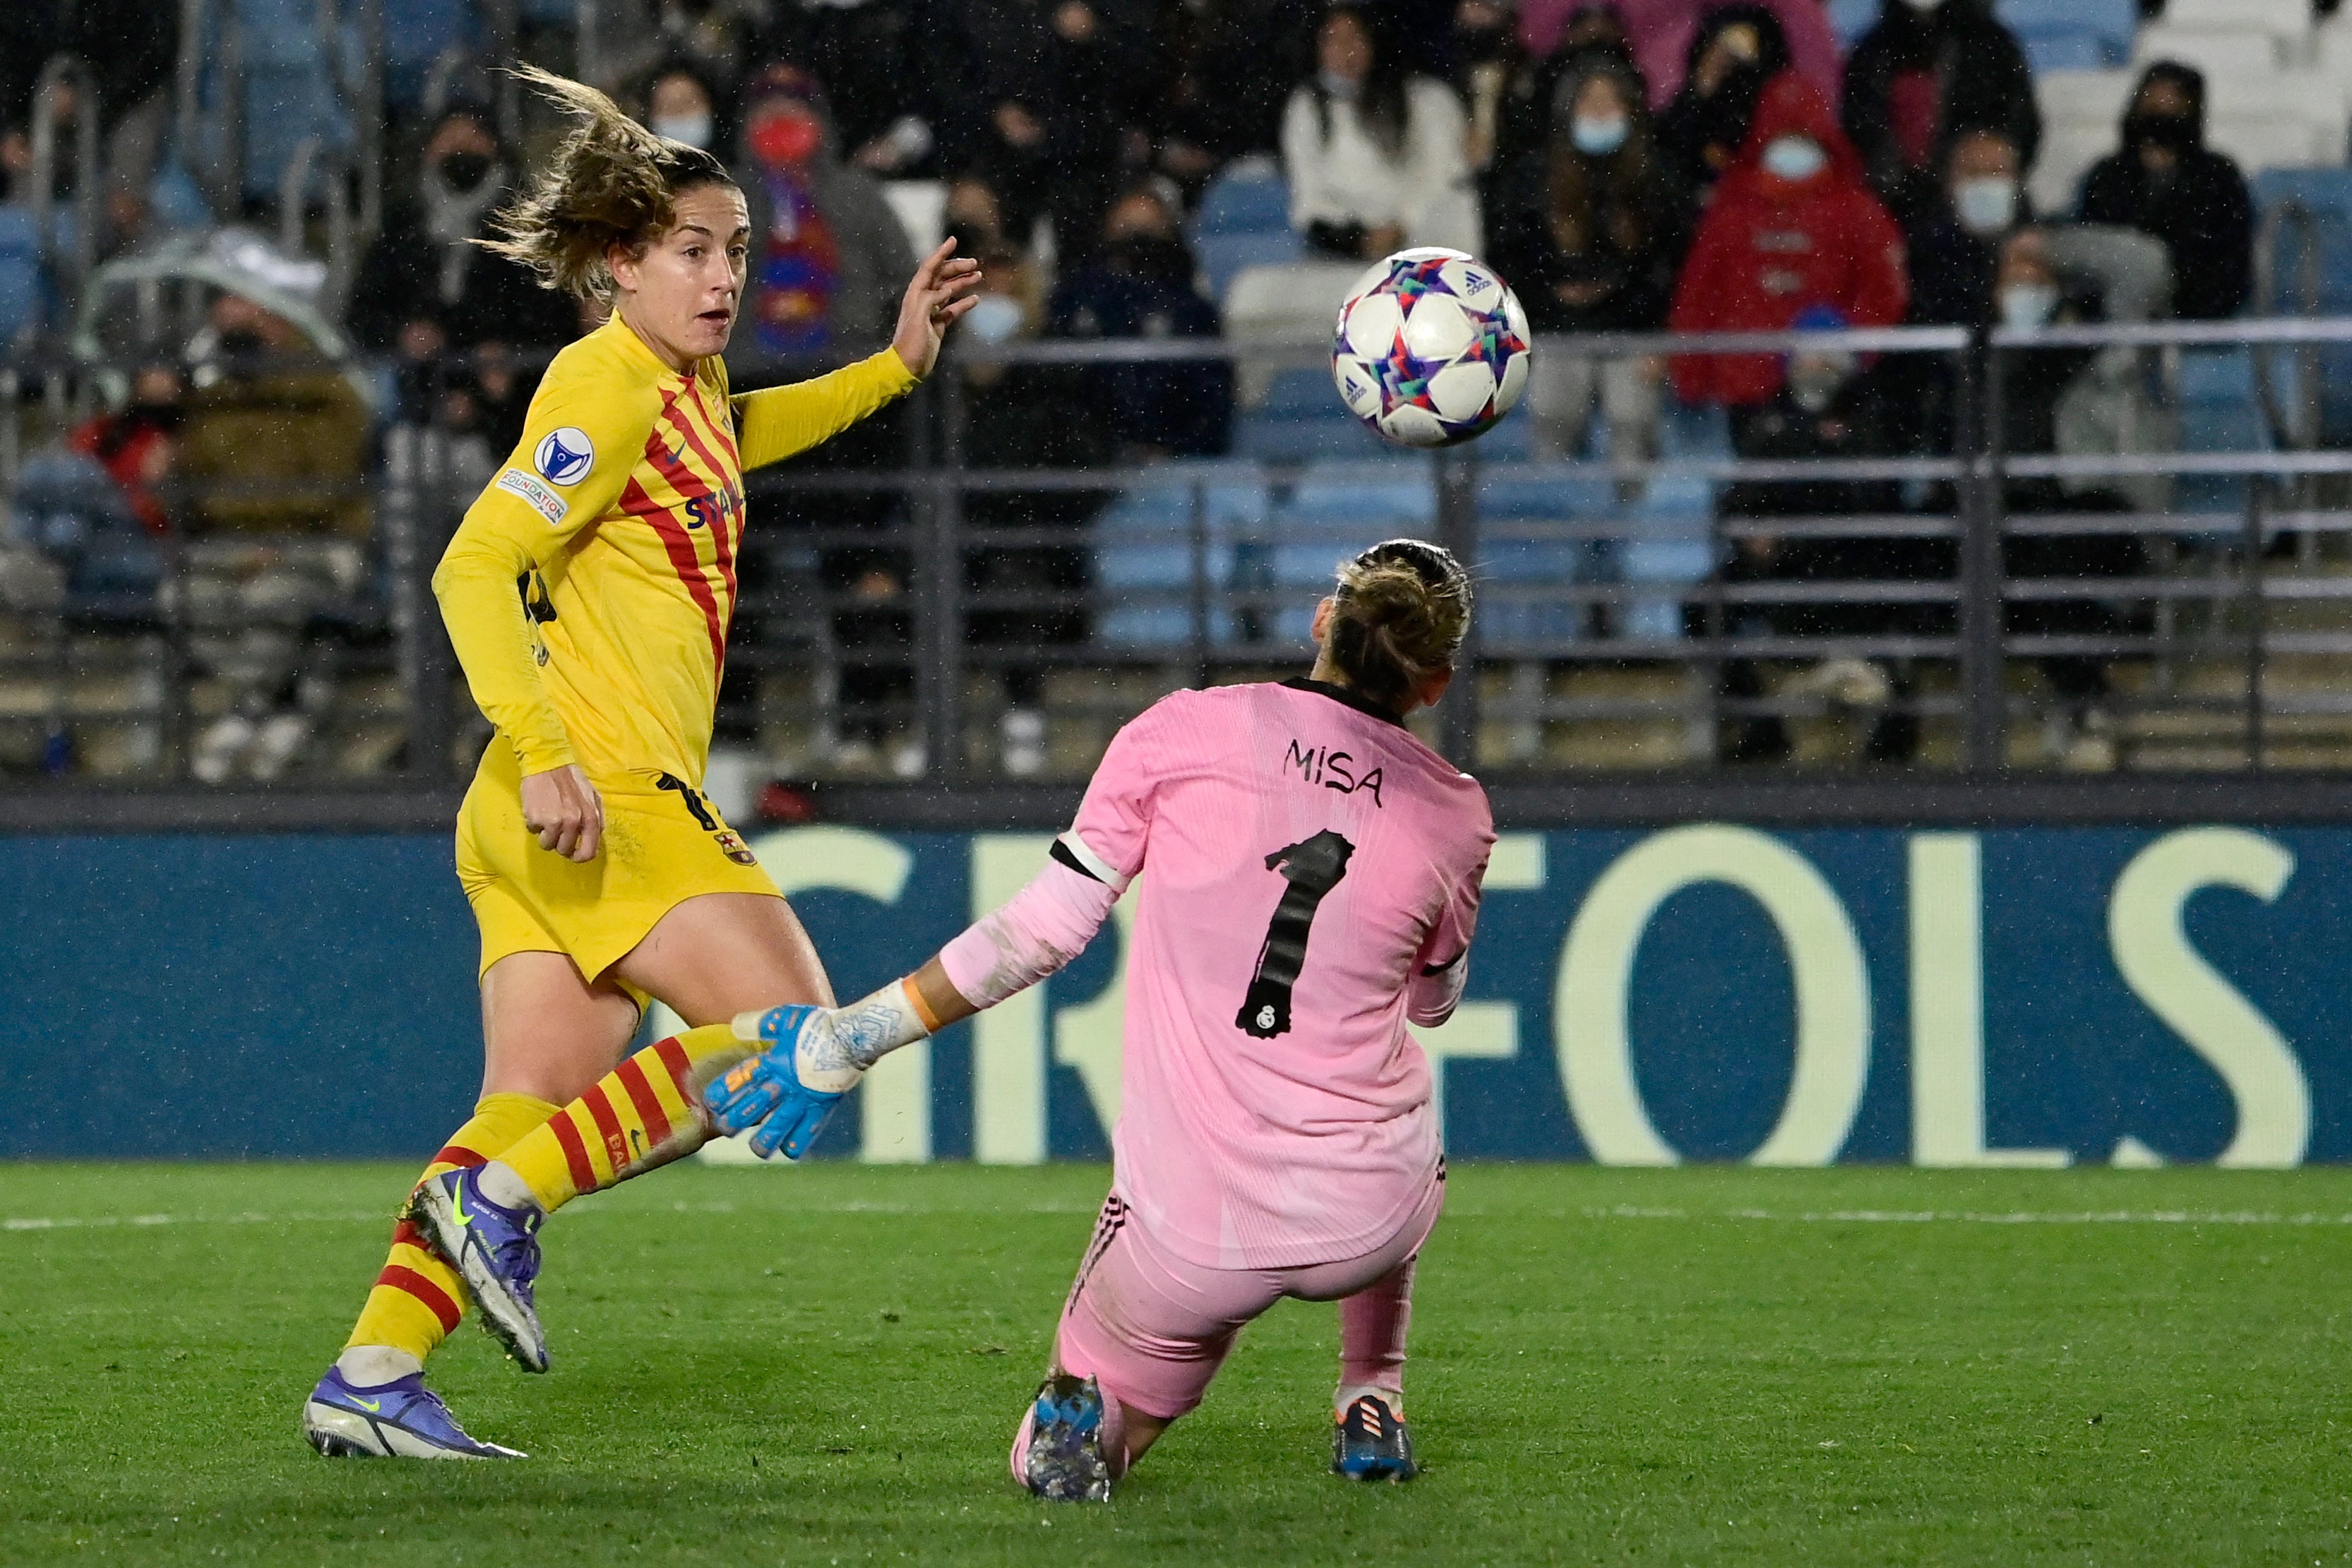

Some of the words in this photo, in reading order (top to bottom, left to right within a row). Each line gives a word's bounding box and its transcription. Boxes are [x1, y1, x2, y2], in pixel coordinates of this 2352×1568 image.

[502, 474, 563, 518] FOUNDATION
[1283, 739, 1383, 808] MISA
[648, 821, 2313, 1168] GRFOLS
[1235, 828, 1356, 1039] 1
